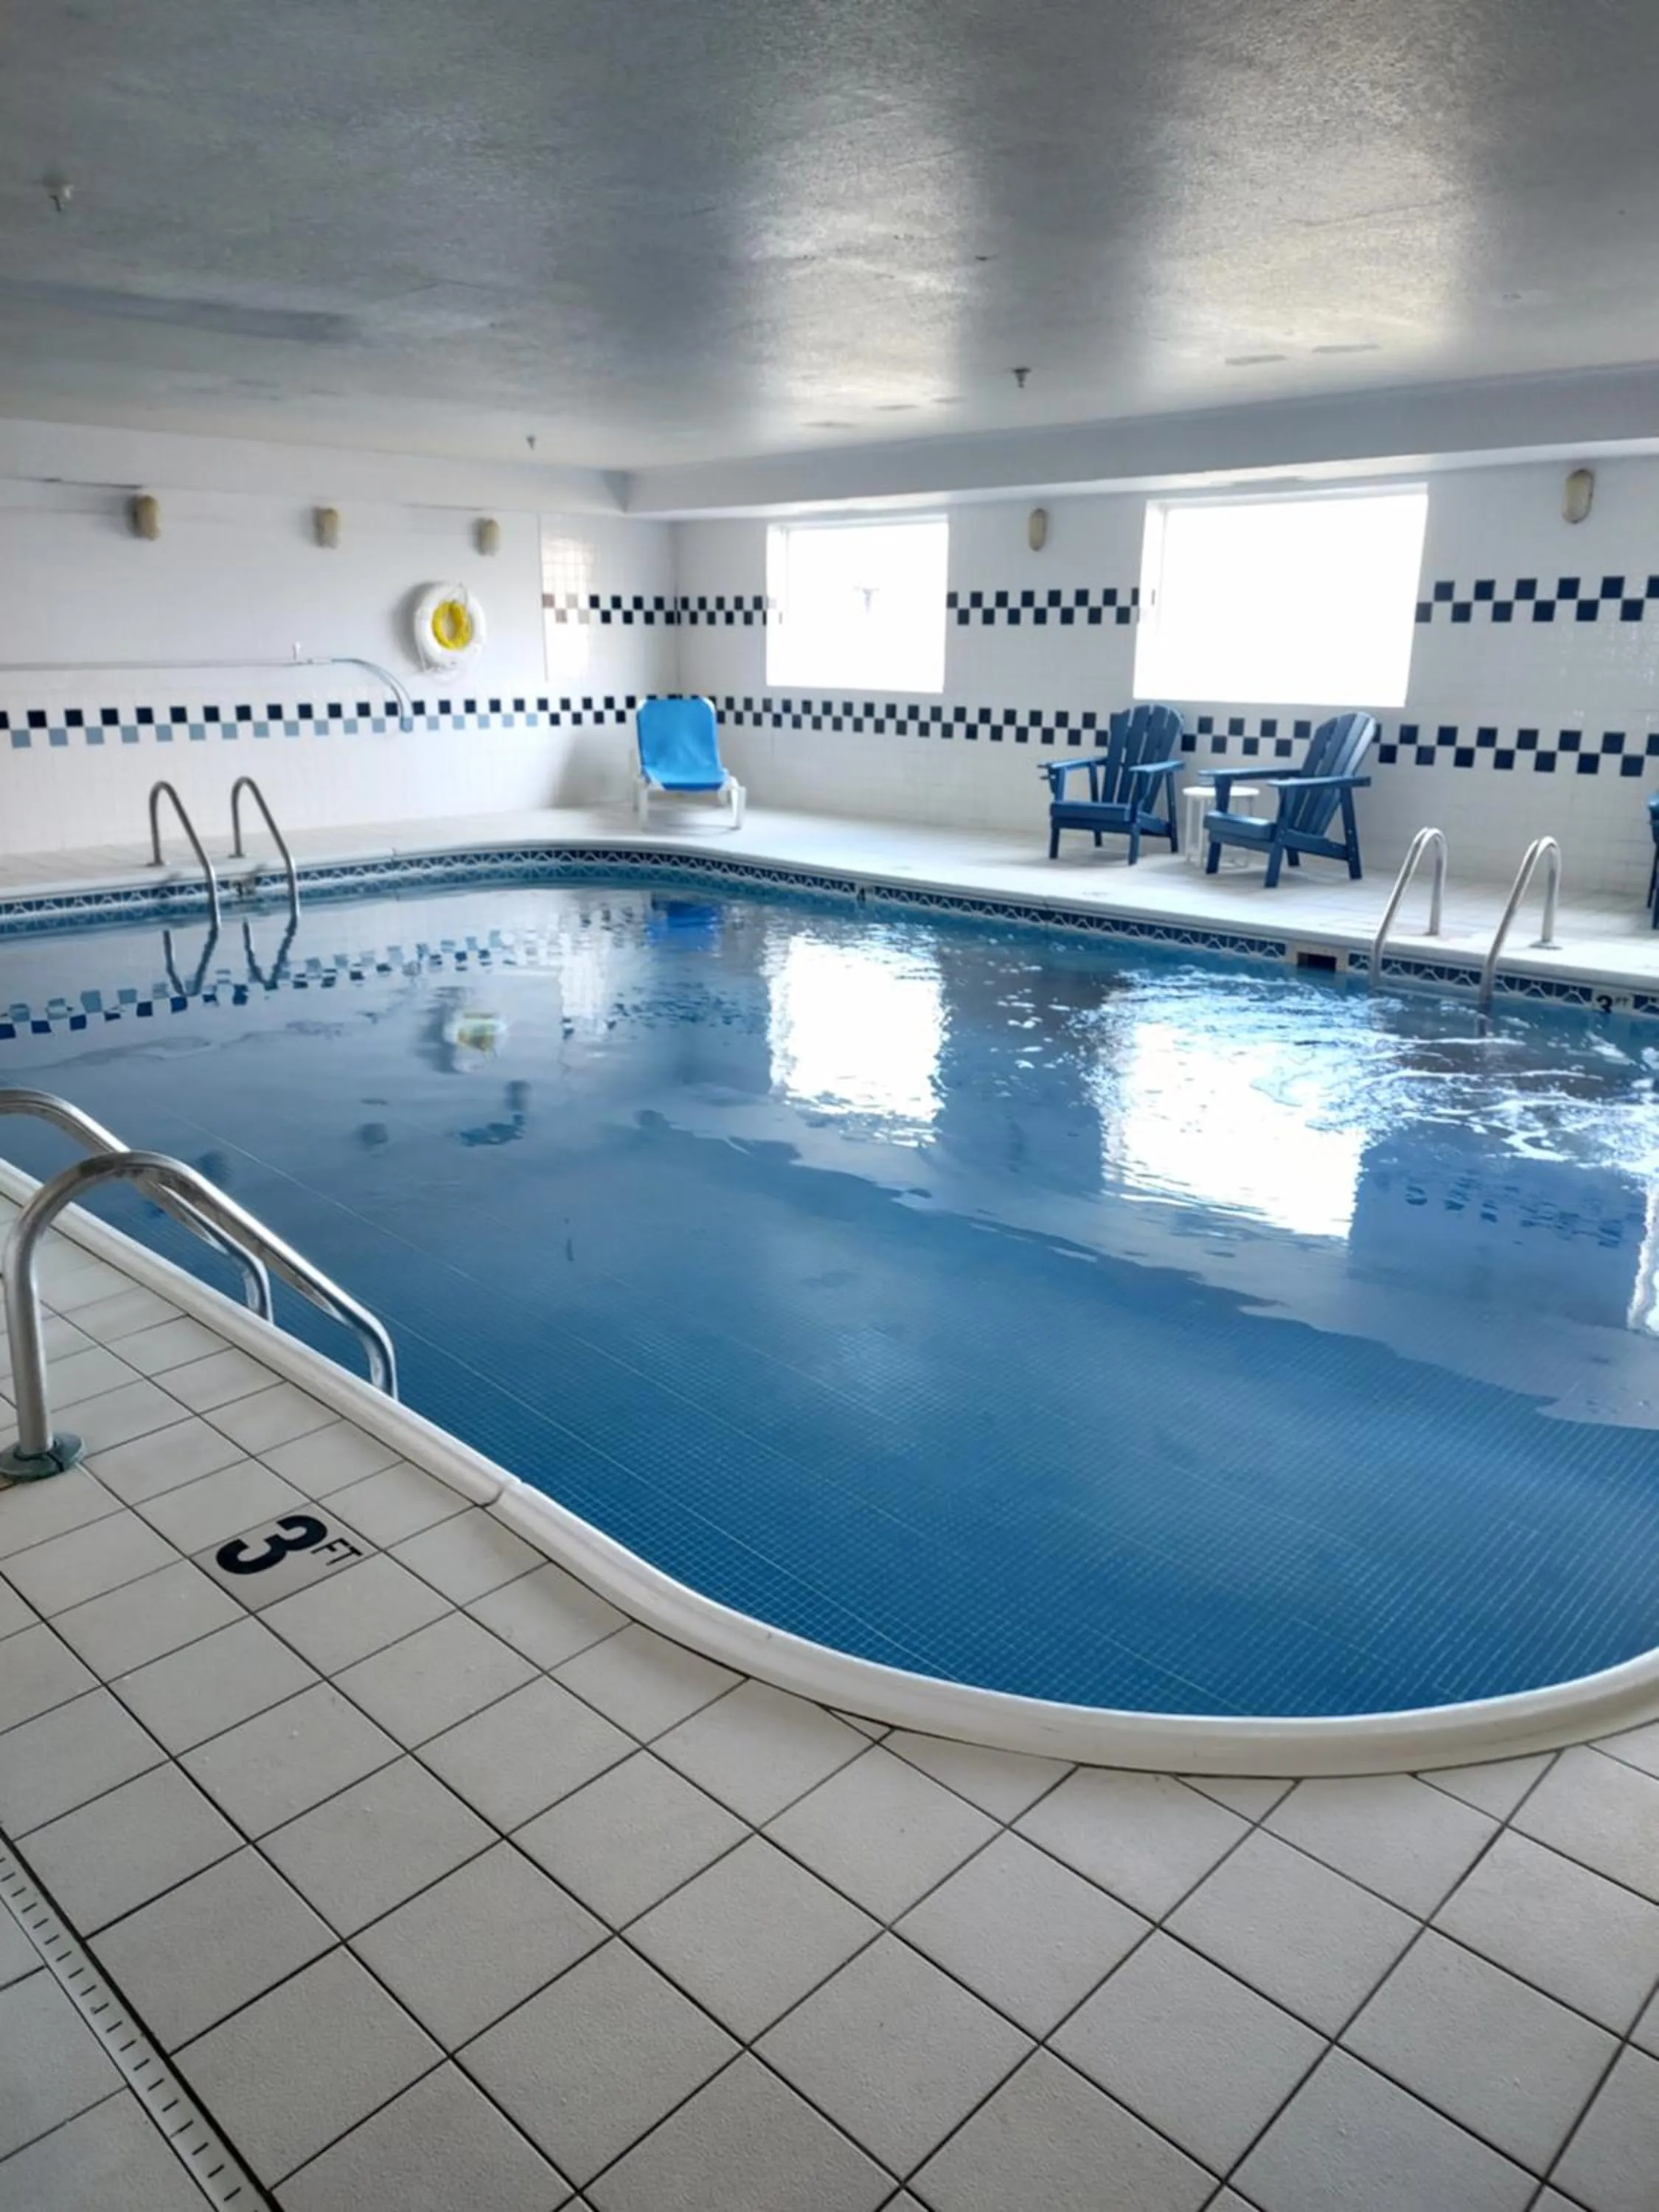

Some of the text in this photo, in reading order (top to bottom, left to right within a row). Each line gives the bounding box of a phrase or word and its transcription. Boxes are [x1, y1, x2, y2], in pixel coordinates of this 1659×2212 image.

[1596, 995, 1613, 1013] 3
[216, 1514, 362, 1574] 3 FT
